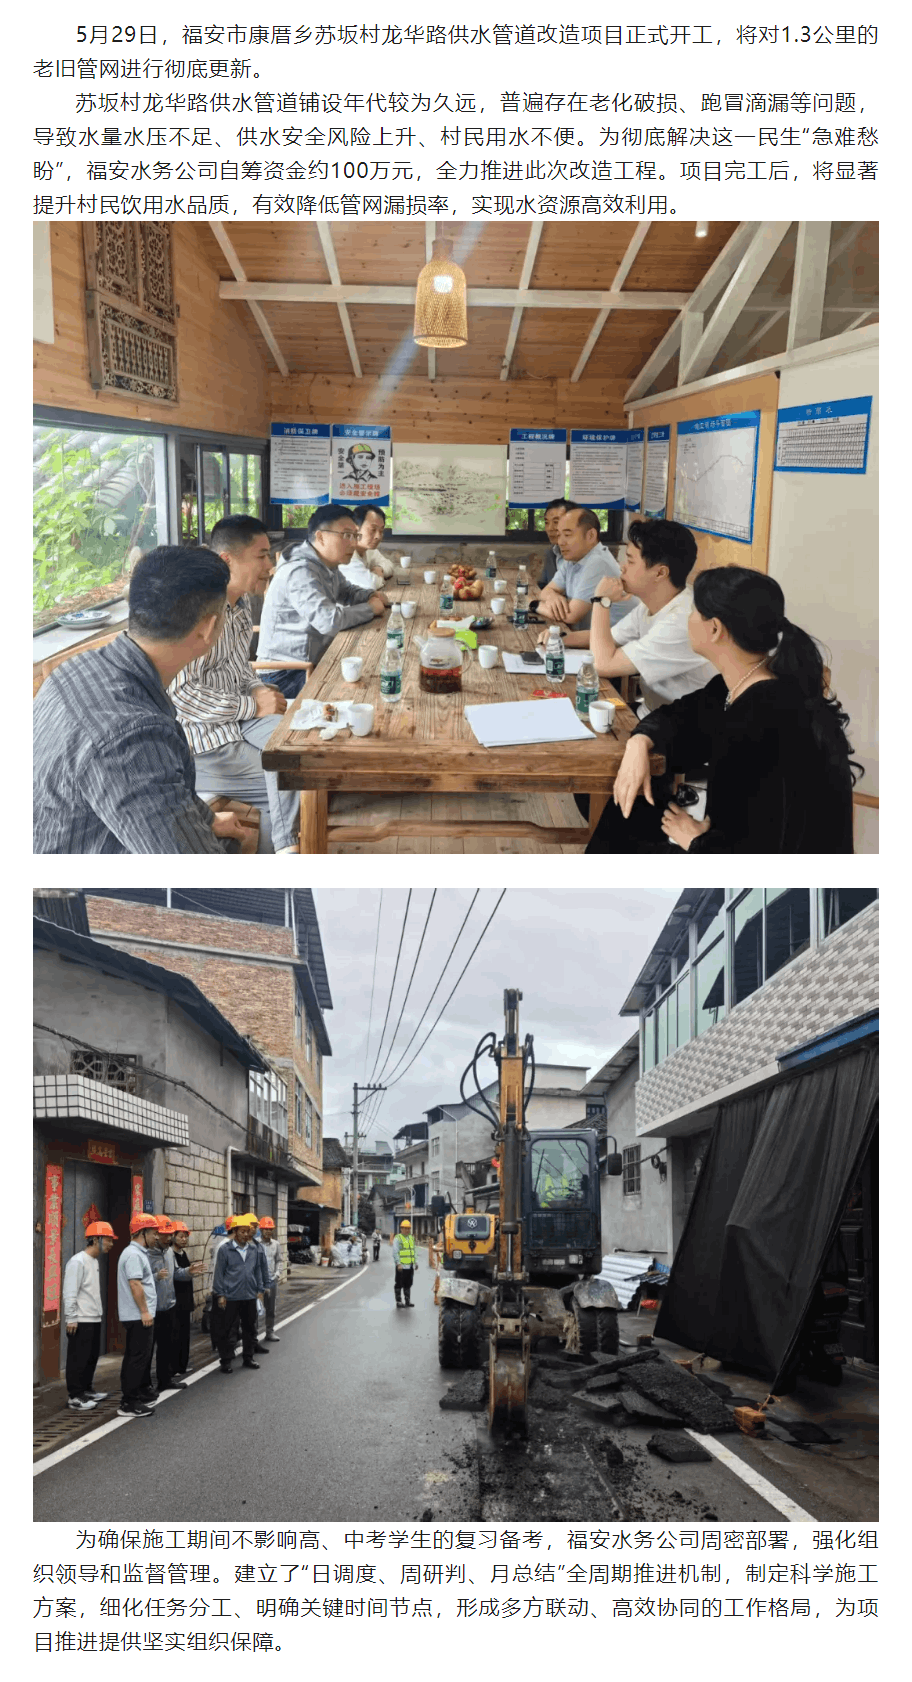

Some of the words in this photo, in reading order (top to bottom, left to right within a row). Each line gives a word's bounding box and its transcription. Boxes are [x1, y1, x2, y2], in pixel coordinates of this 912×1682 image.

[337, 447, 345, 474] 安全第一
[377, 448, 386, 478] 预防为主
